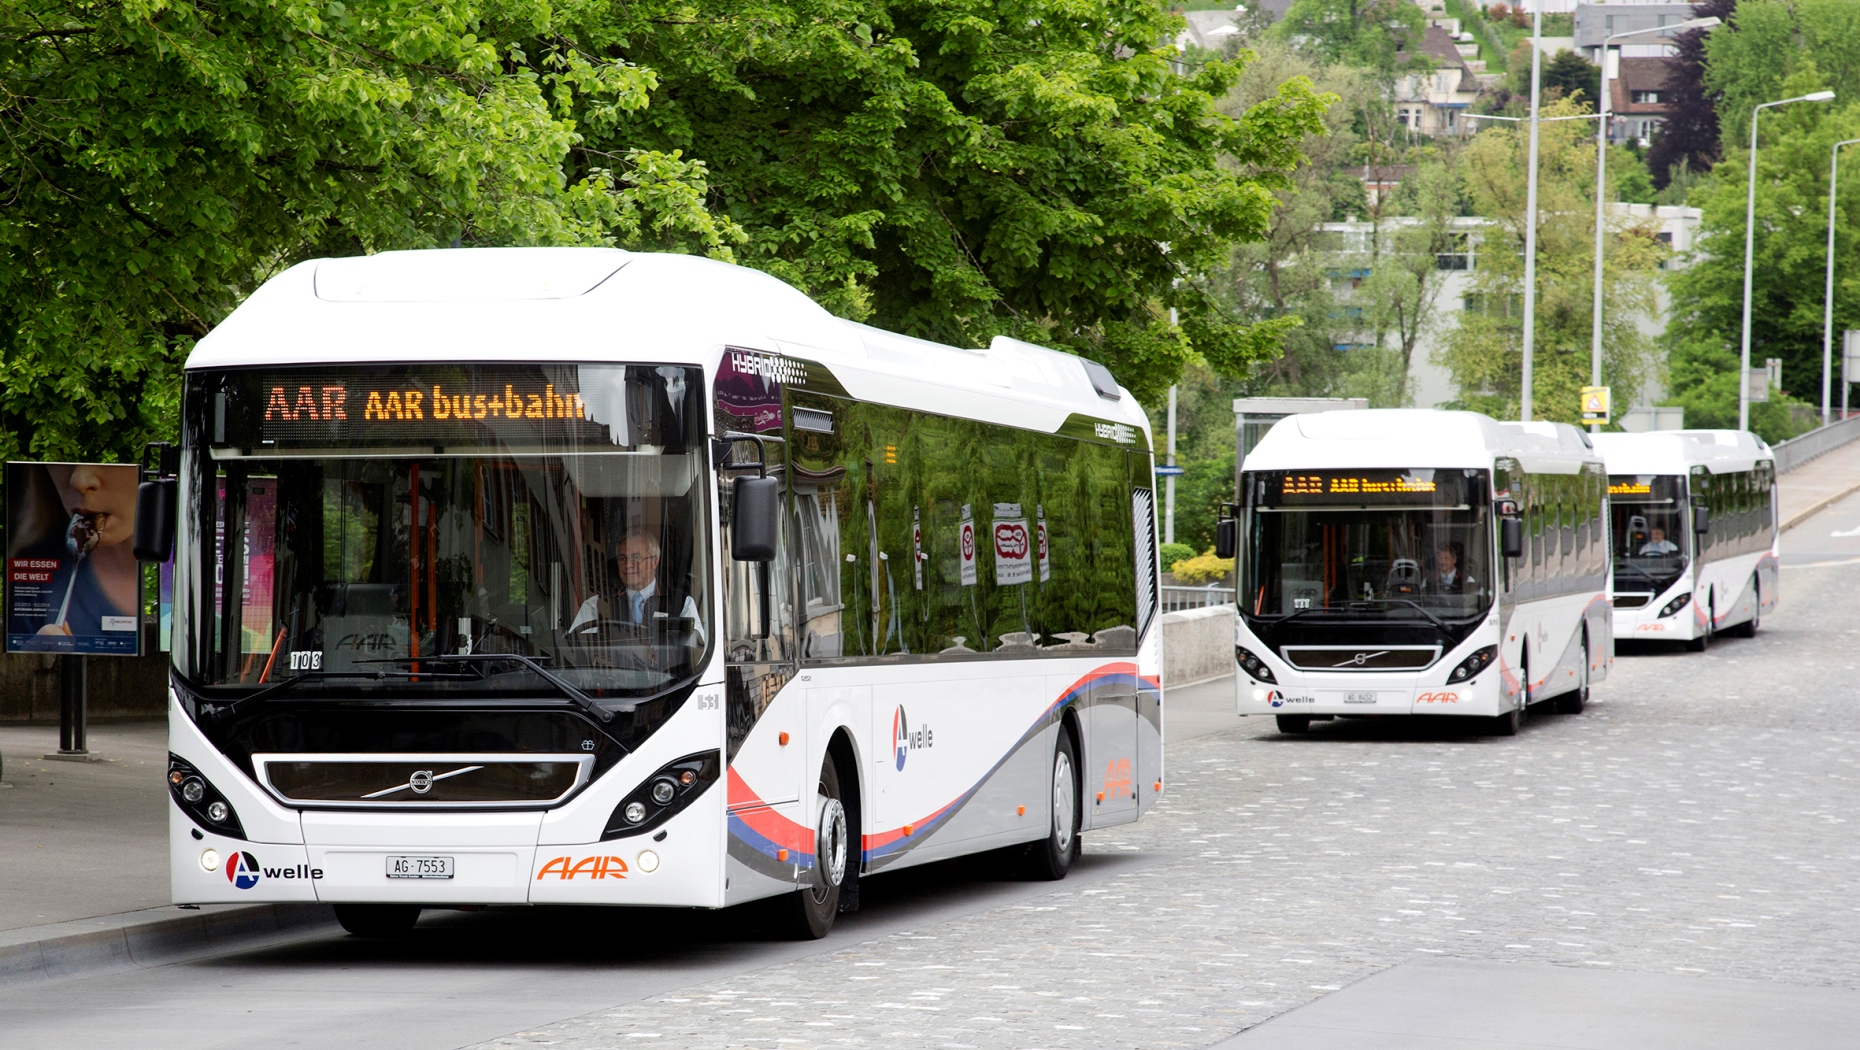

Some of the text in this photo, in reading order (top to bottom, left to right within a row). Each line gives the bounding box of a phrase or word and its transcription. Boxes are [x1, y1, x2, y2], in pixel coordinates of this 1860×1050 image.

[731, 352, 771, 378] HYBRID
[265, 384, 584, 420] AAR AAR bus+bahn
[14, 560, 28, 568] WIR
[335, 634, 397, 650] AAR
[291, 652, 321, 669] 103
[1286, 696, 1315, 704] welle
[1417, 693, 1458, 703] AAR
[909, 723, 933, 750] welle
[263, 864, 323, 879] welle
[537, 856, 628, 880] AAR
